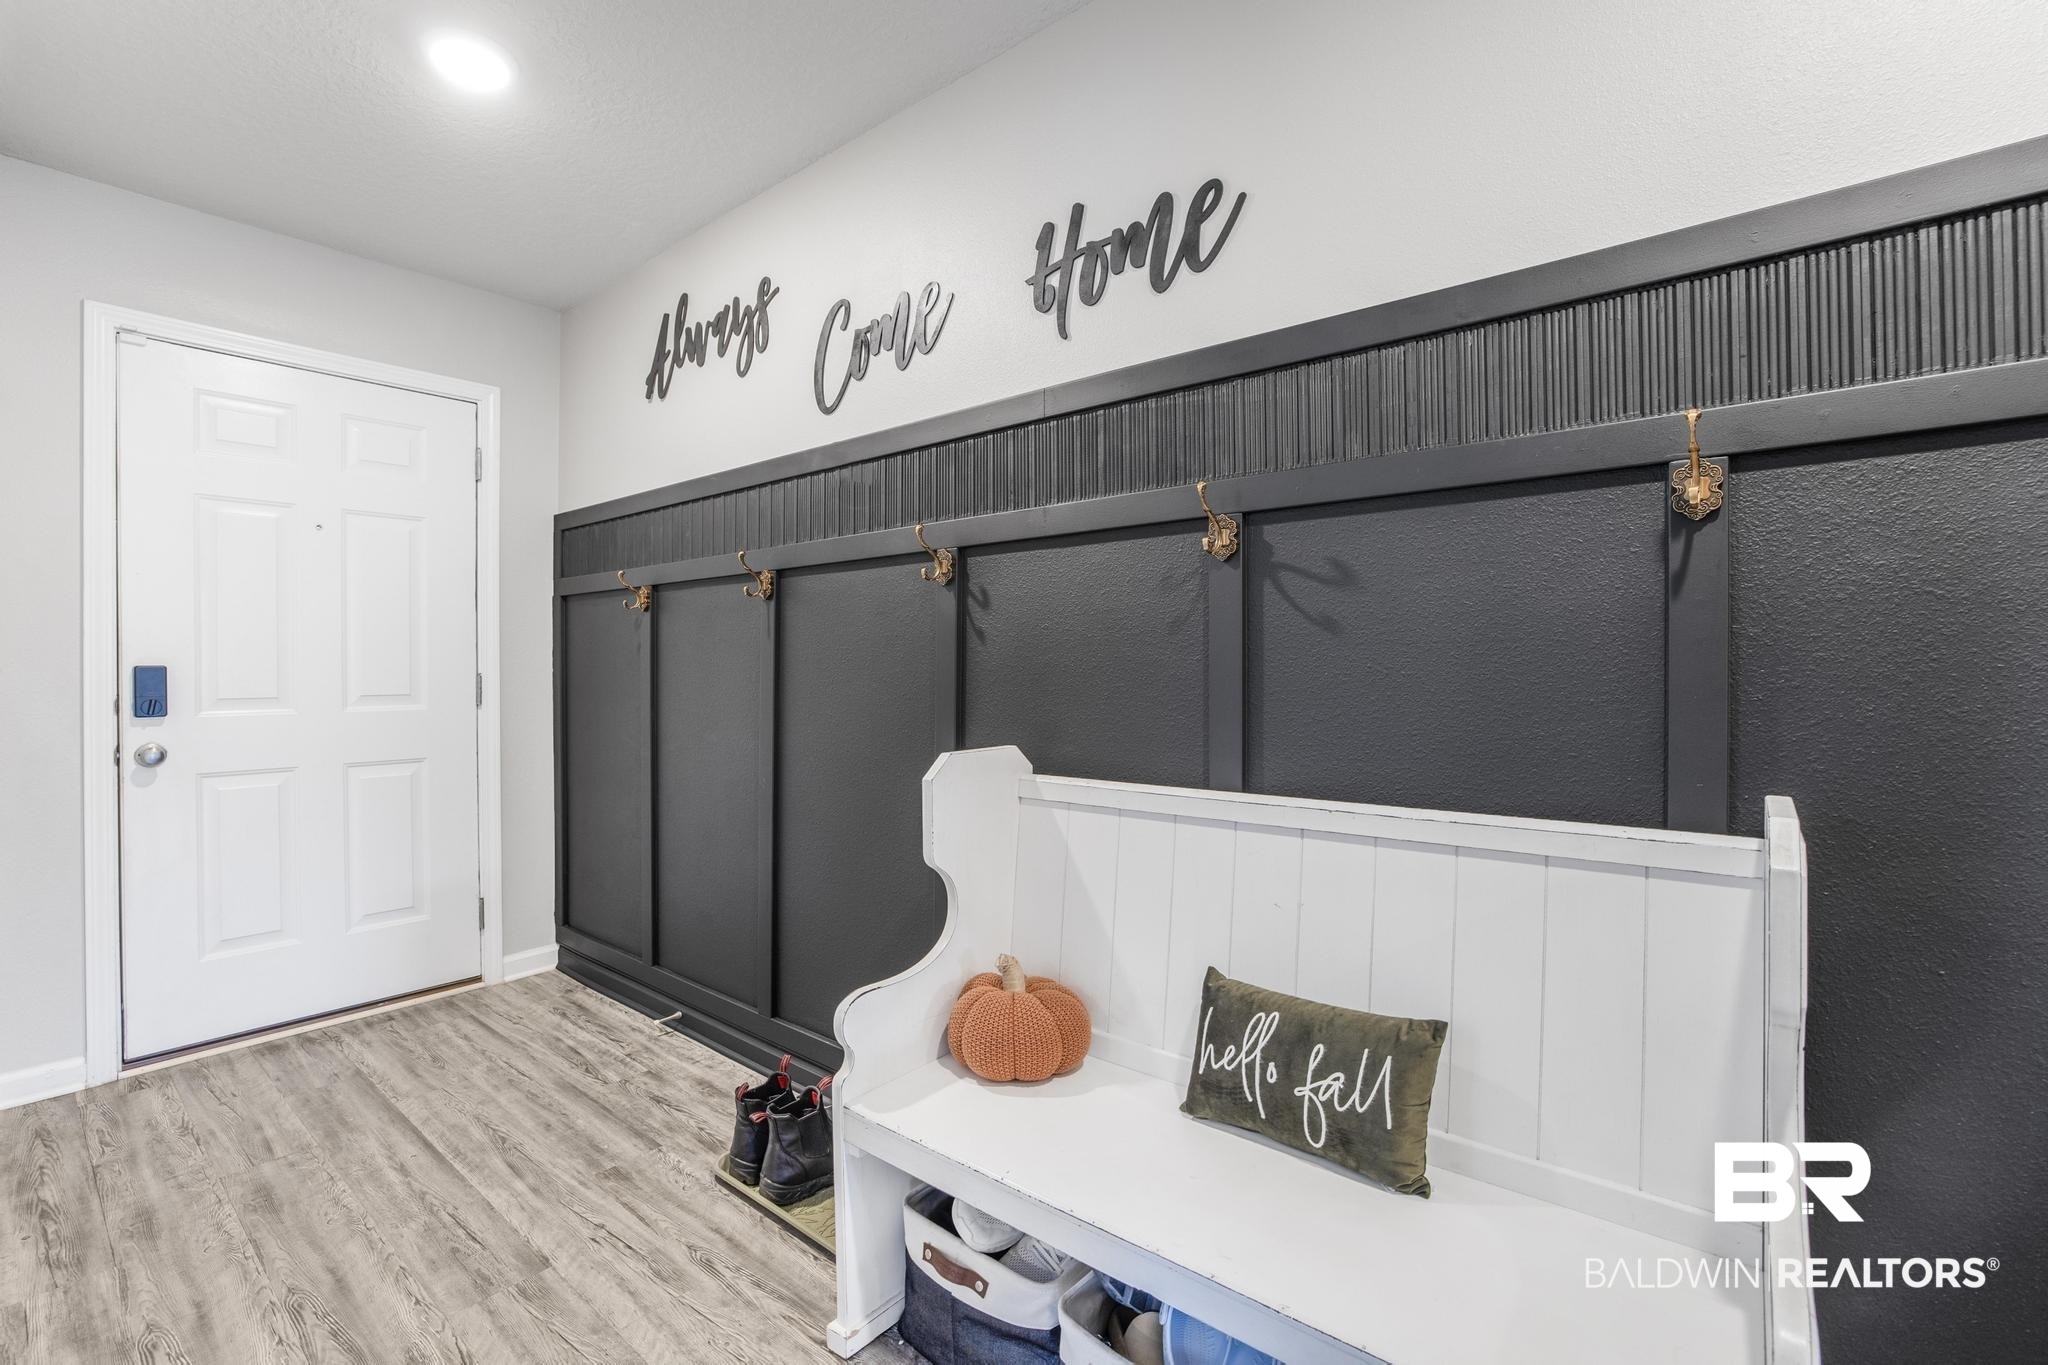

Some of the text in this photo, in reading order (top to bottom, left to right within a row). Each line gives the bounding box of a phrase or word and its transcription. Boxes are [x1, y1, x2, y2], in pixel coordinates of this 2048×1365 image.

[646, 178, 1247, 415] Always Come Home
[1198, 1006, 1392, 1148] hello fall
